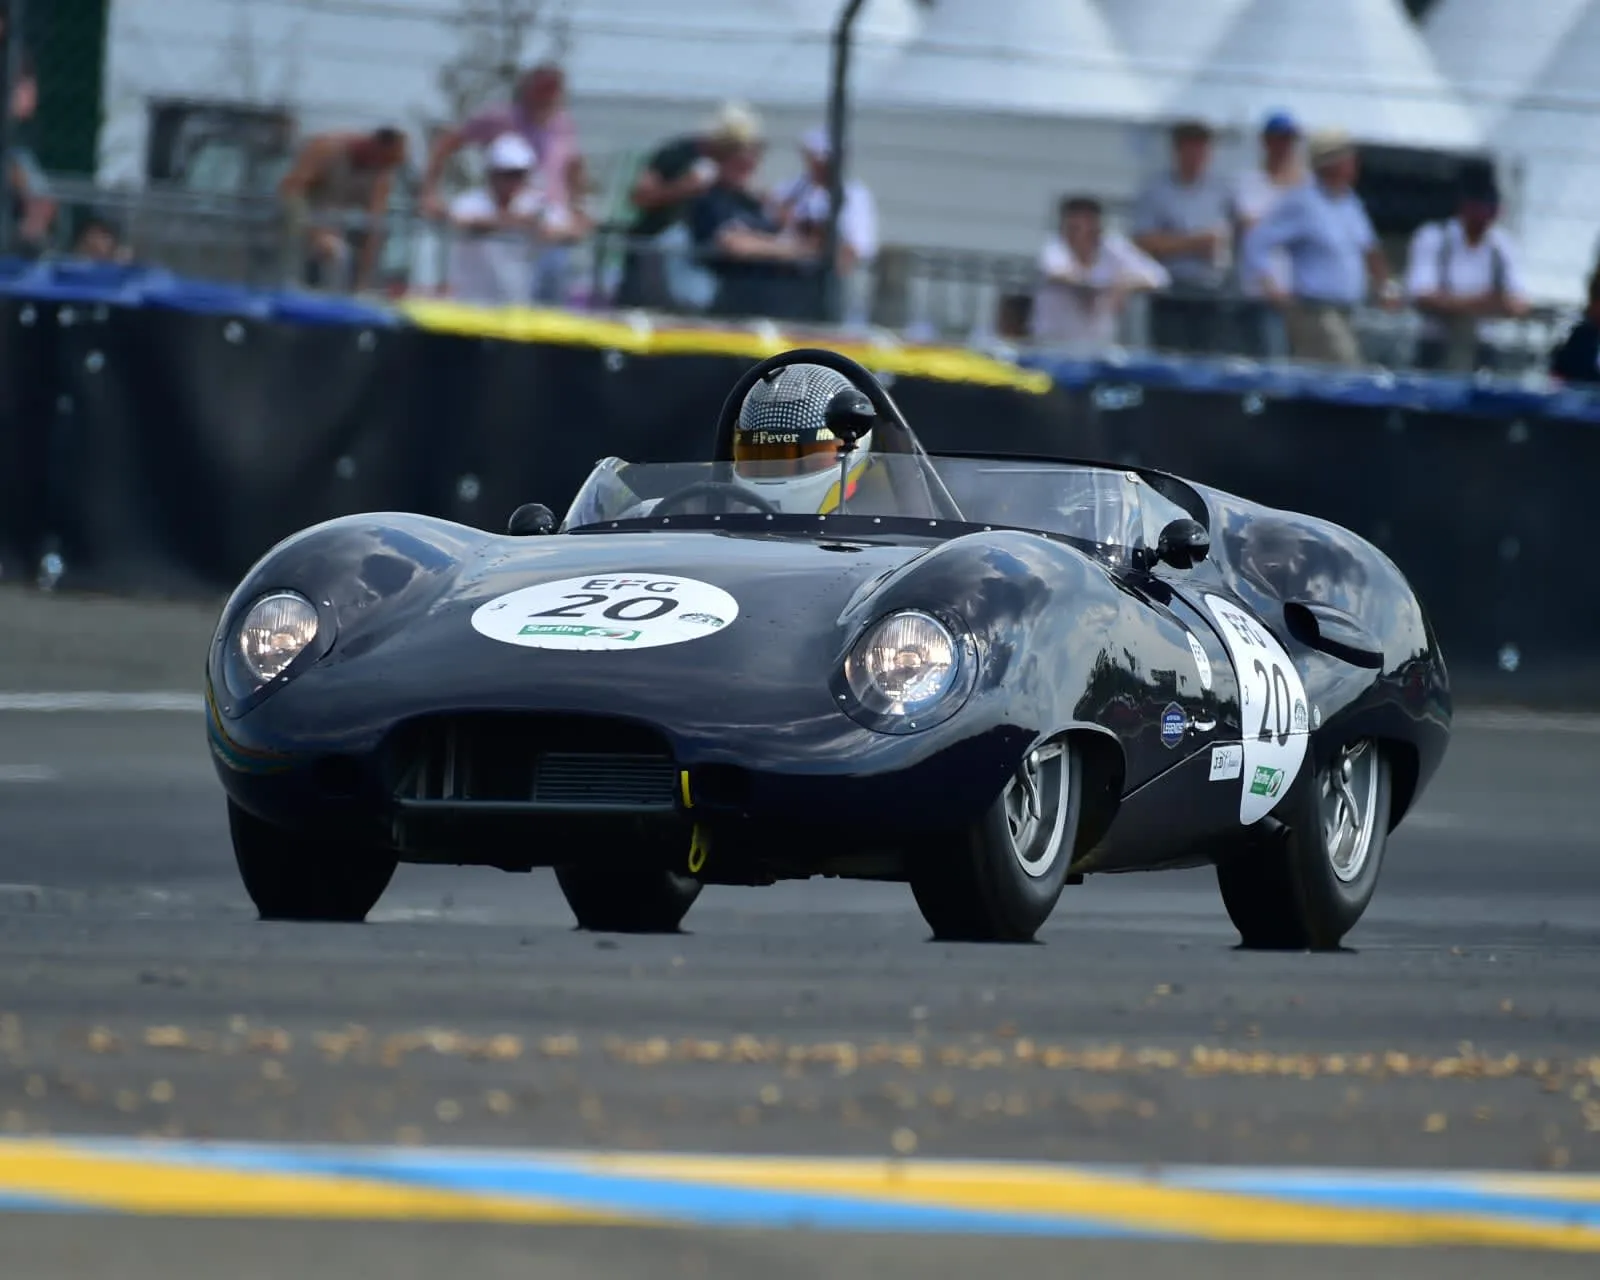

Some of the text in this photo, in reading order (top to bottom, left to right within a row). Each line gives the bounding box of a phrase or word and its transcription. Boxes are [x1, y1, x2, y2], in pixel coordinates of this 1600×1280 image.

[752, 431, 799, 445] #Fever
[581, 578, 681, 593] EFG
[528, 593, 680, 621] 20
[525, 624, 584, 634] Sarthe
[1253, 658, 1291, 747] 20
